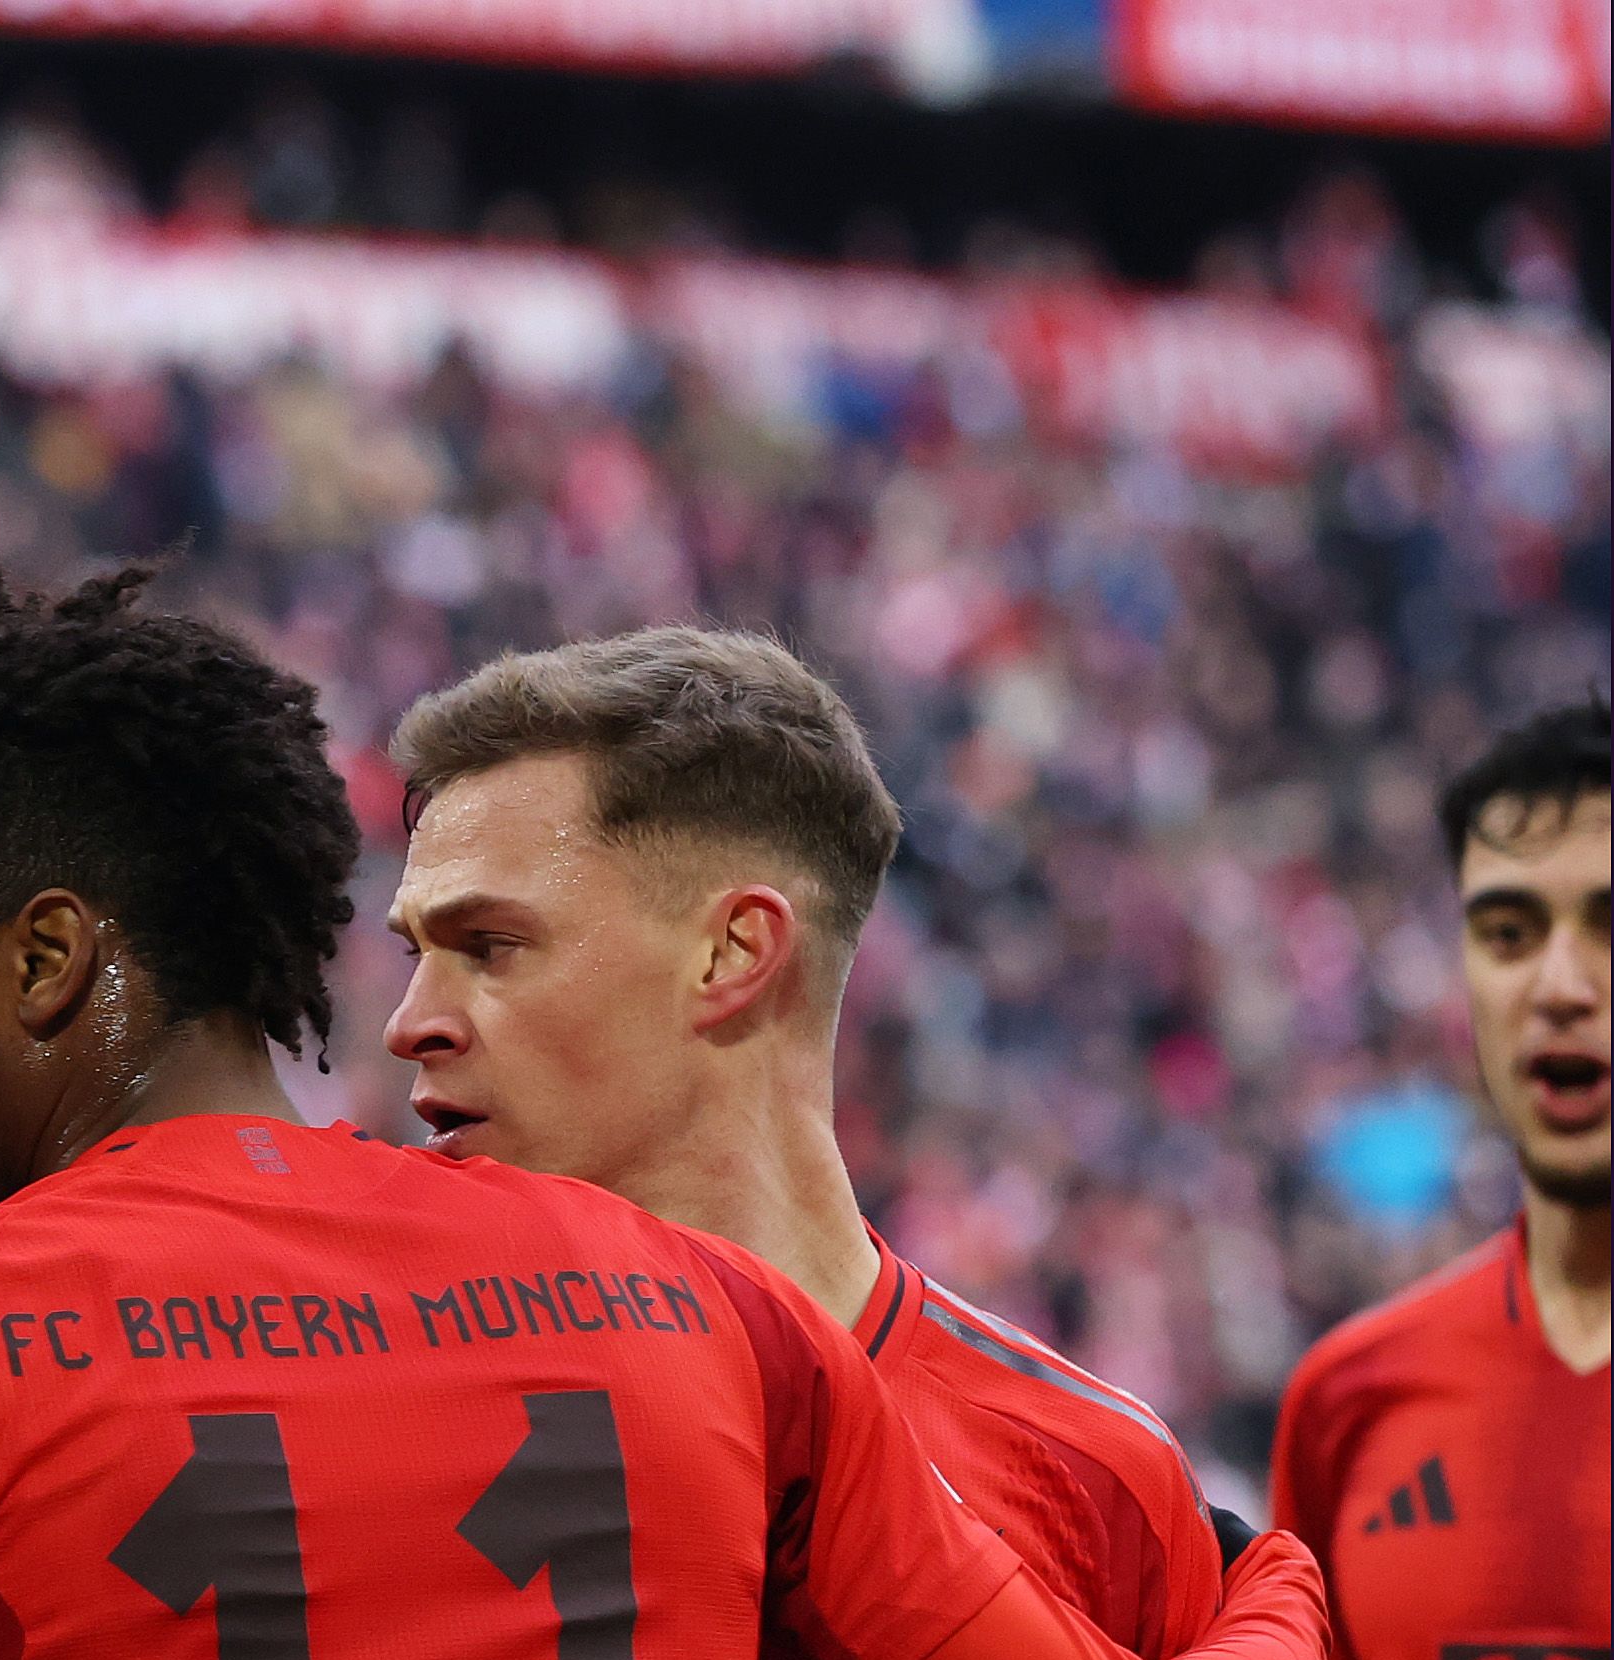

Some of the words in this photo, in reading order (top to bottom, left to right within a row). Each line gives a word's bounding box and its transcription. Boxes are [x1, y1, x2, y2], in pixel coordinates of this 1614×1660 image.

[0, 1310, 94, 1377] FC
[116, 1292, 391, 1361] BAYERN
[409, 1271, 712, 1348] MÜNCHEN
